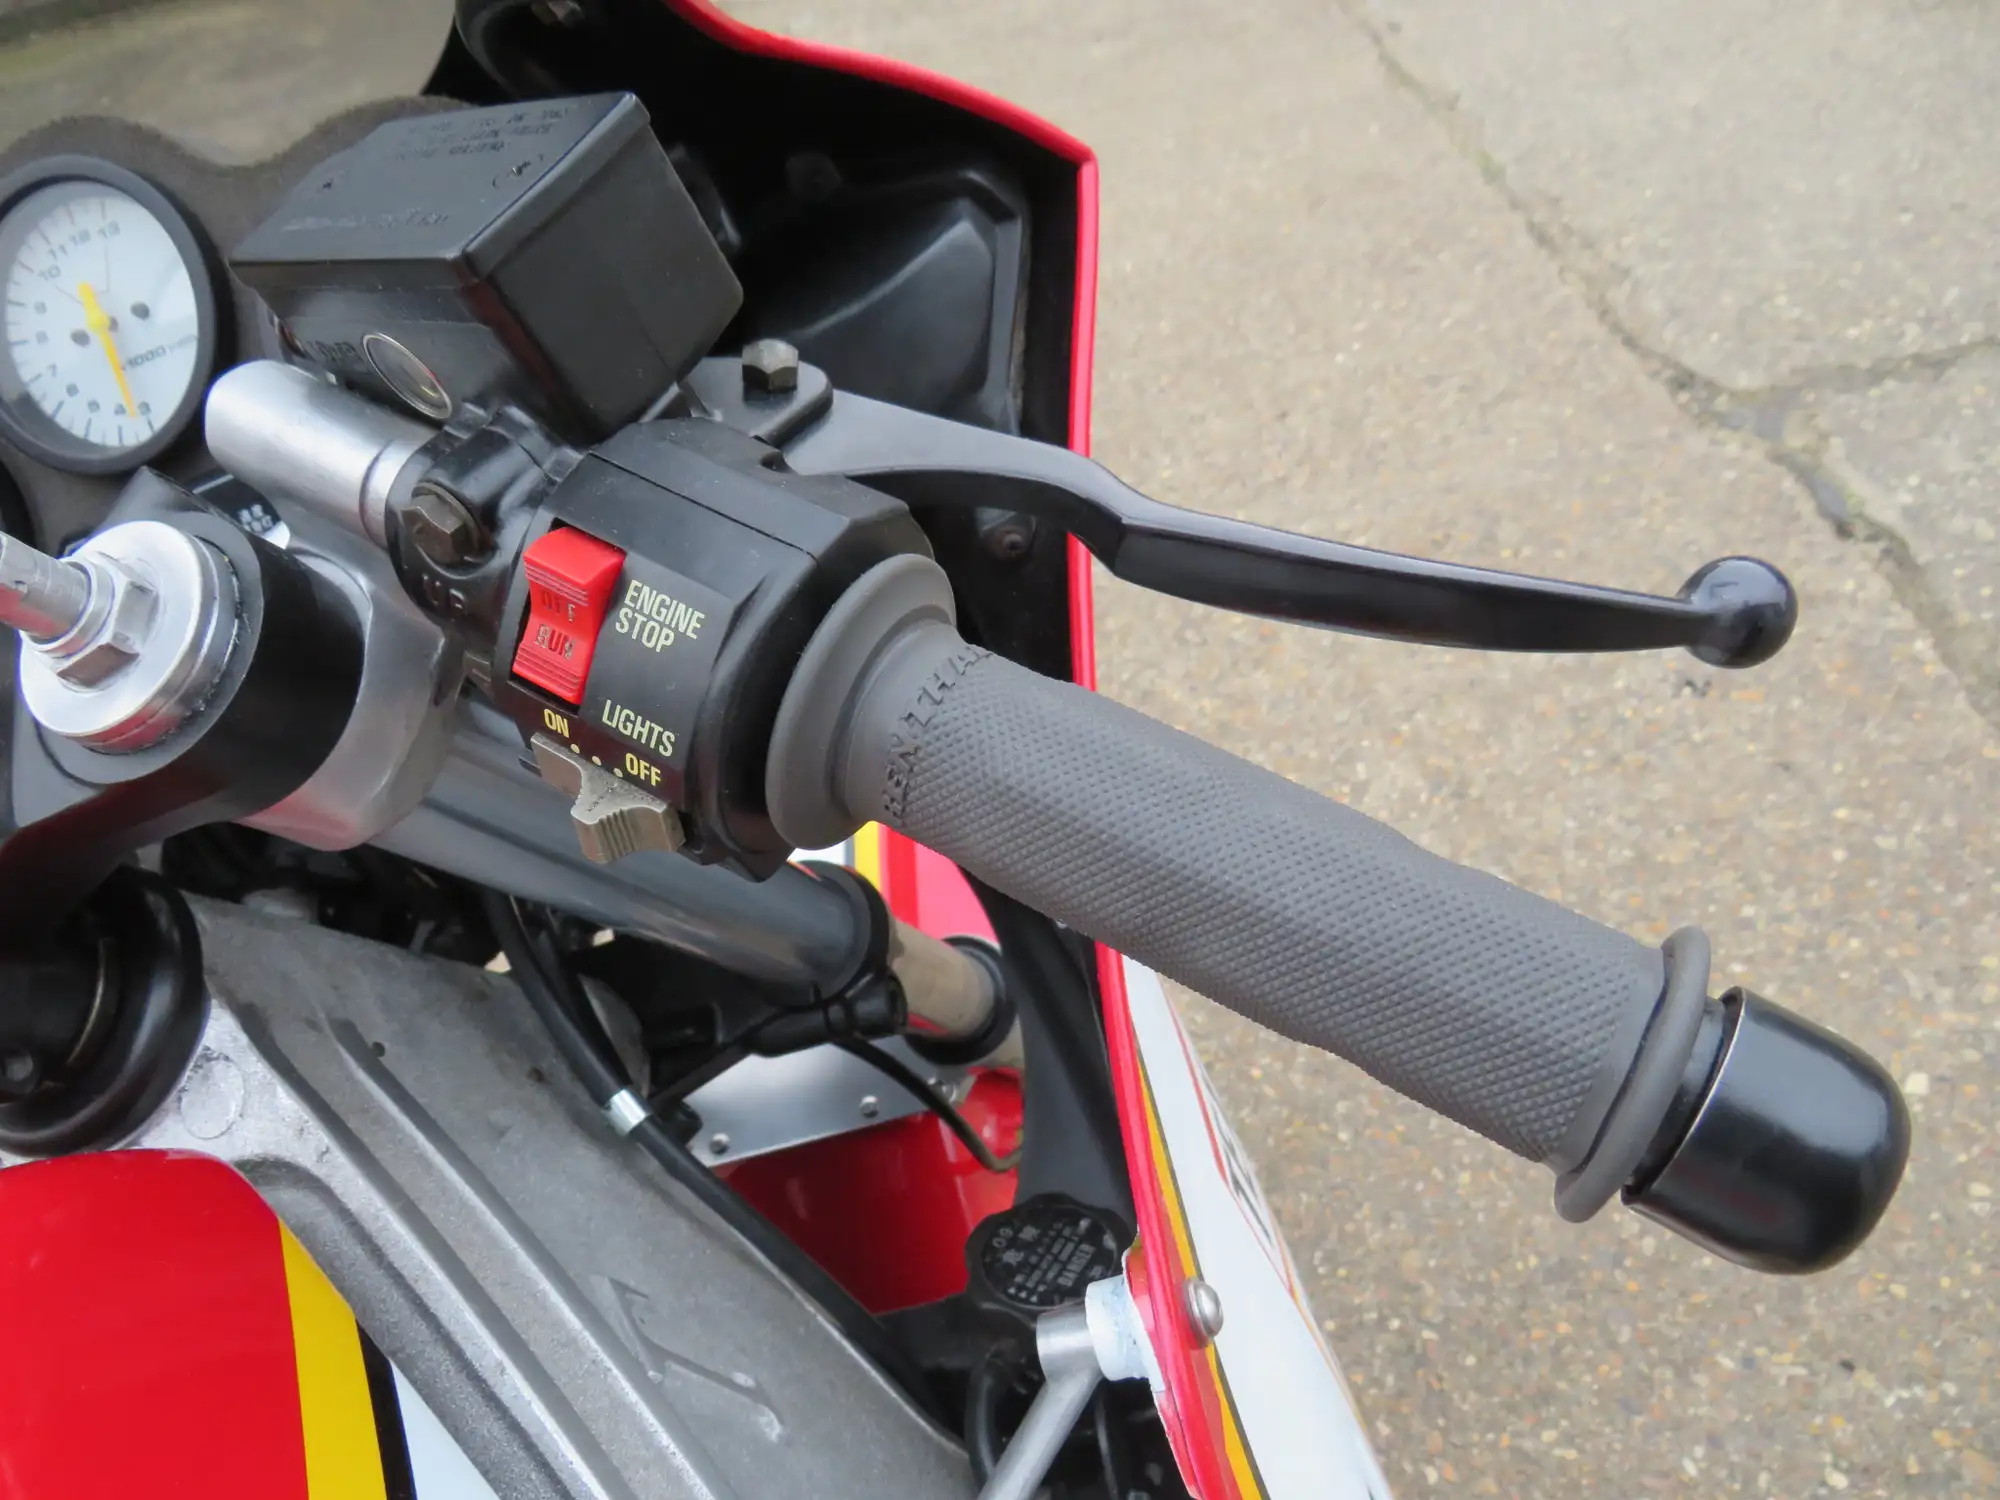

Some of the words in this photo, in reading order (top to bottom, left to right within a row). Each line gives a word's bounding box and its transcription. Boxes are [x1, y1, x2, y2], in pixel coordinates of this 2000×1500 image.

[624, 579, 705, 640] ENGINE
[536, 623, 576, 660] RUN
[615, 608, 675, 653] STOP
[544, 708, 570, 738] ON
[602, 699, 676, 757] LIGHTS
[625, 752, 662, 787] OFF
